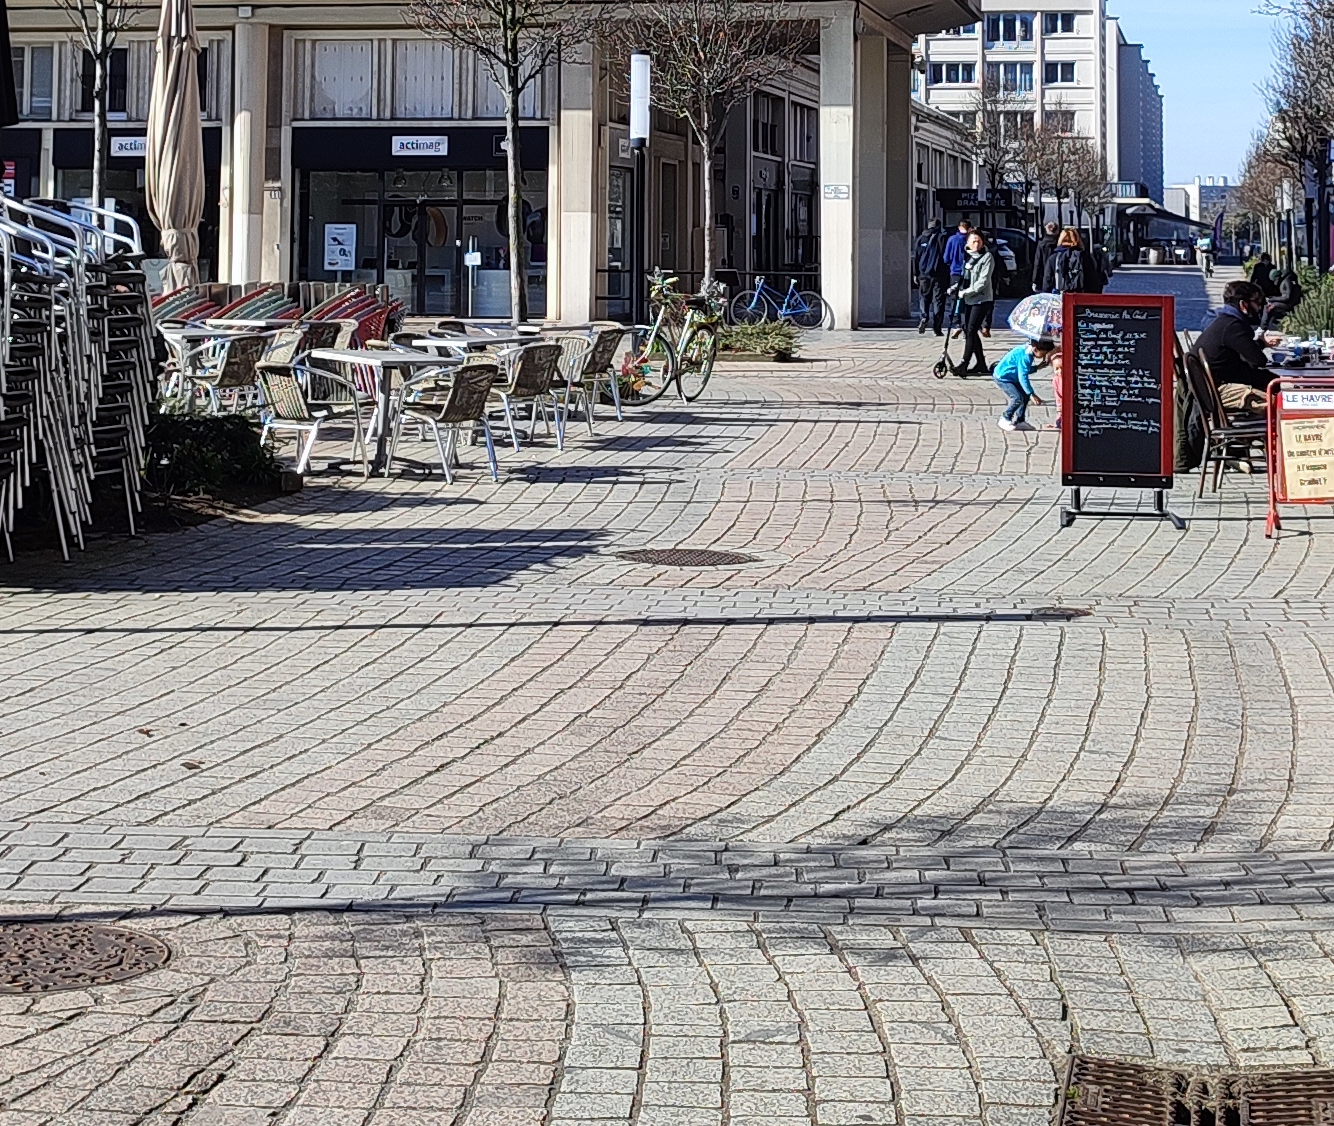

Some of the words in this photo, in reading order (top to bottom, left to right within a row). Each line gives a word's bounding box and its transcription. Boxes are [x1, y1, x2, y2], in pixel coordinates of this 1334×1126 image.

[398, 139, 442, 152] actimag
[1286, 394, 1299, 403] LE
[1301, 394, 1334, 403] HAVRE
